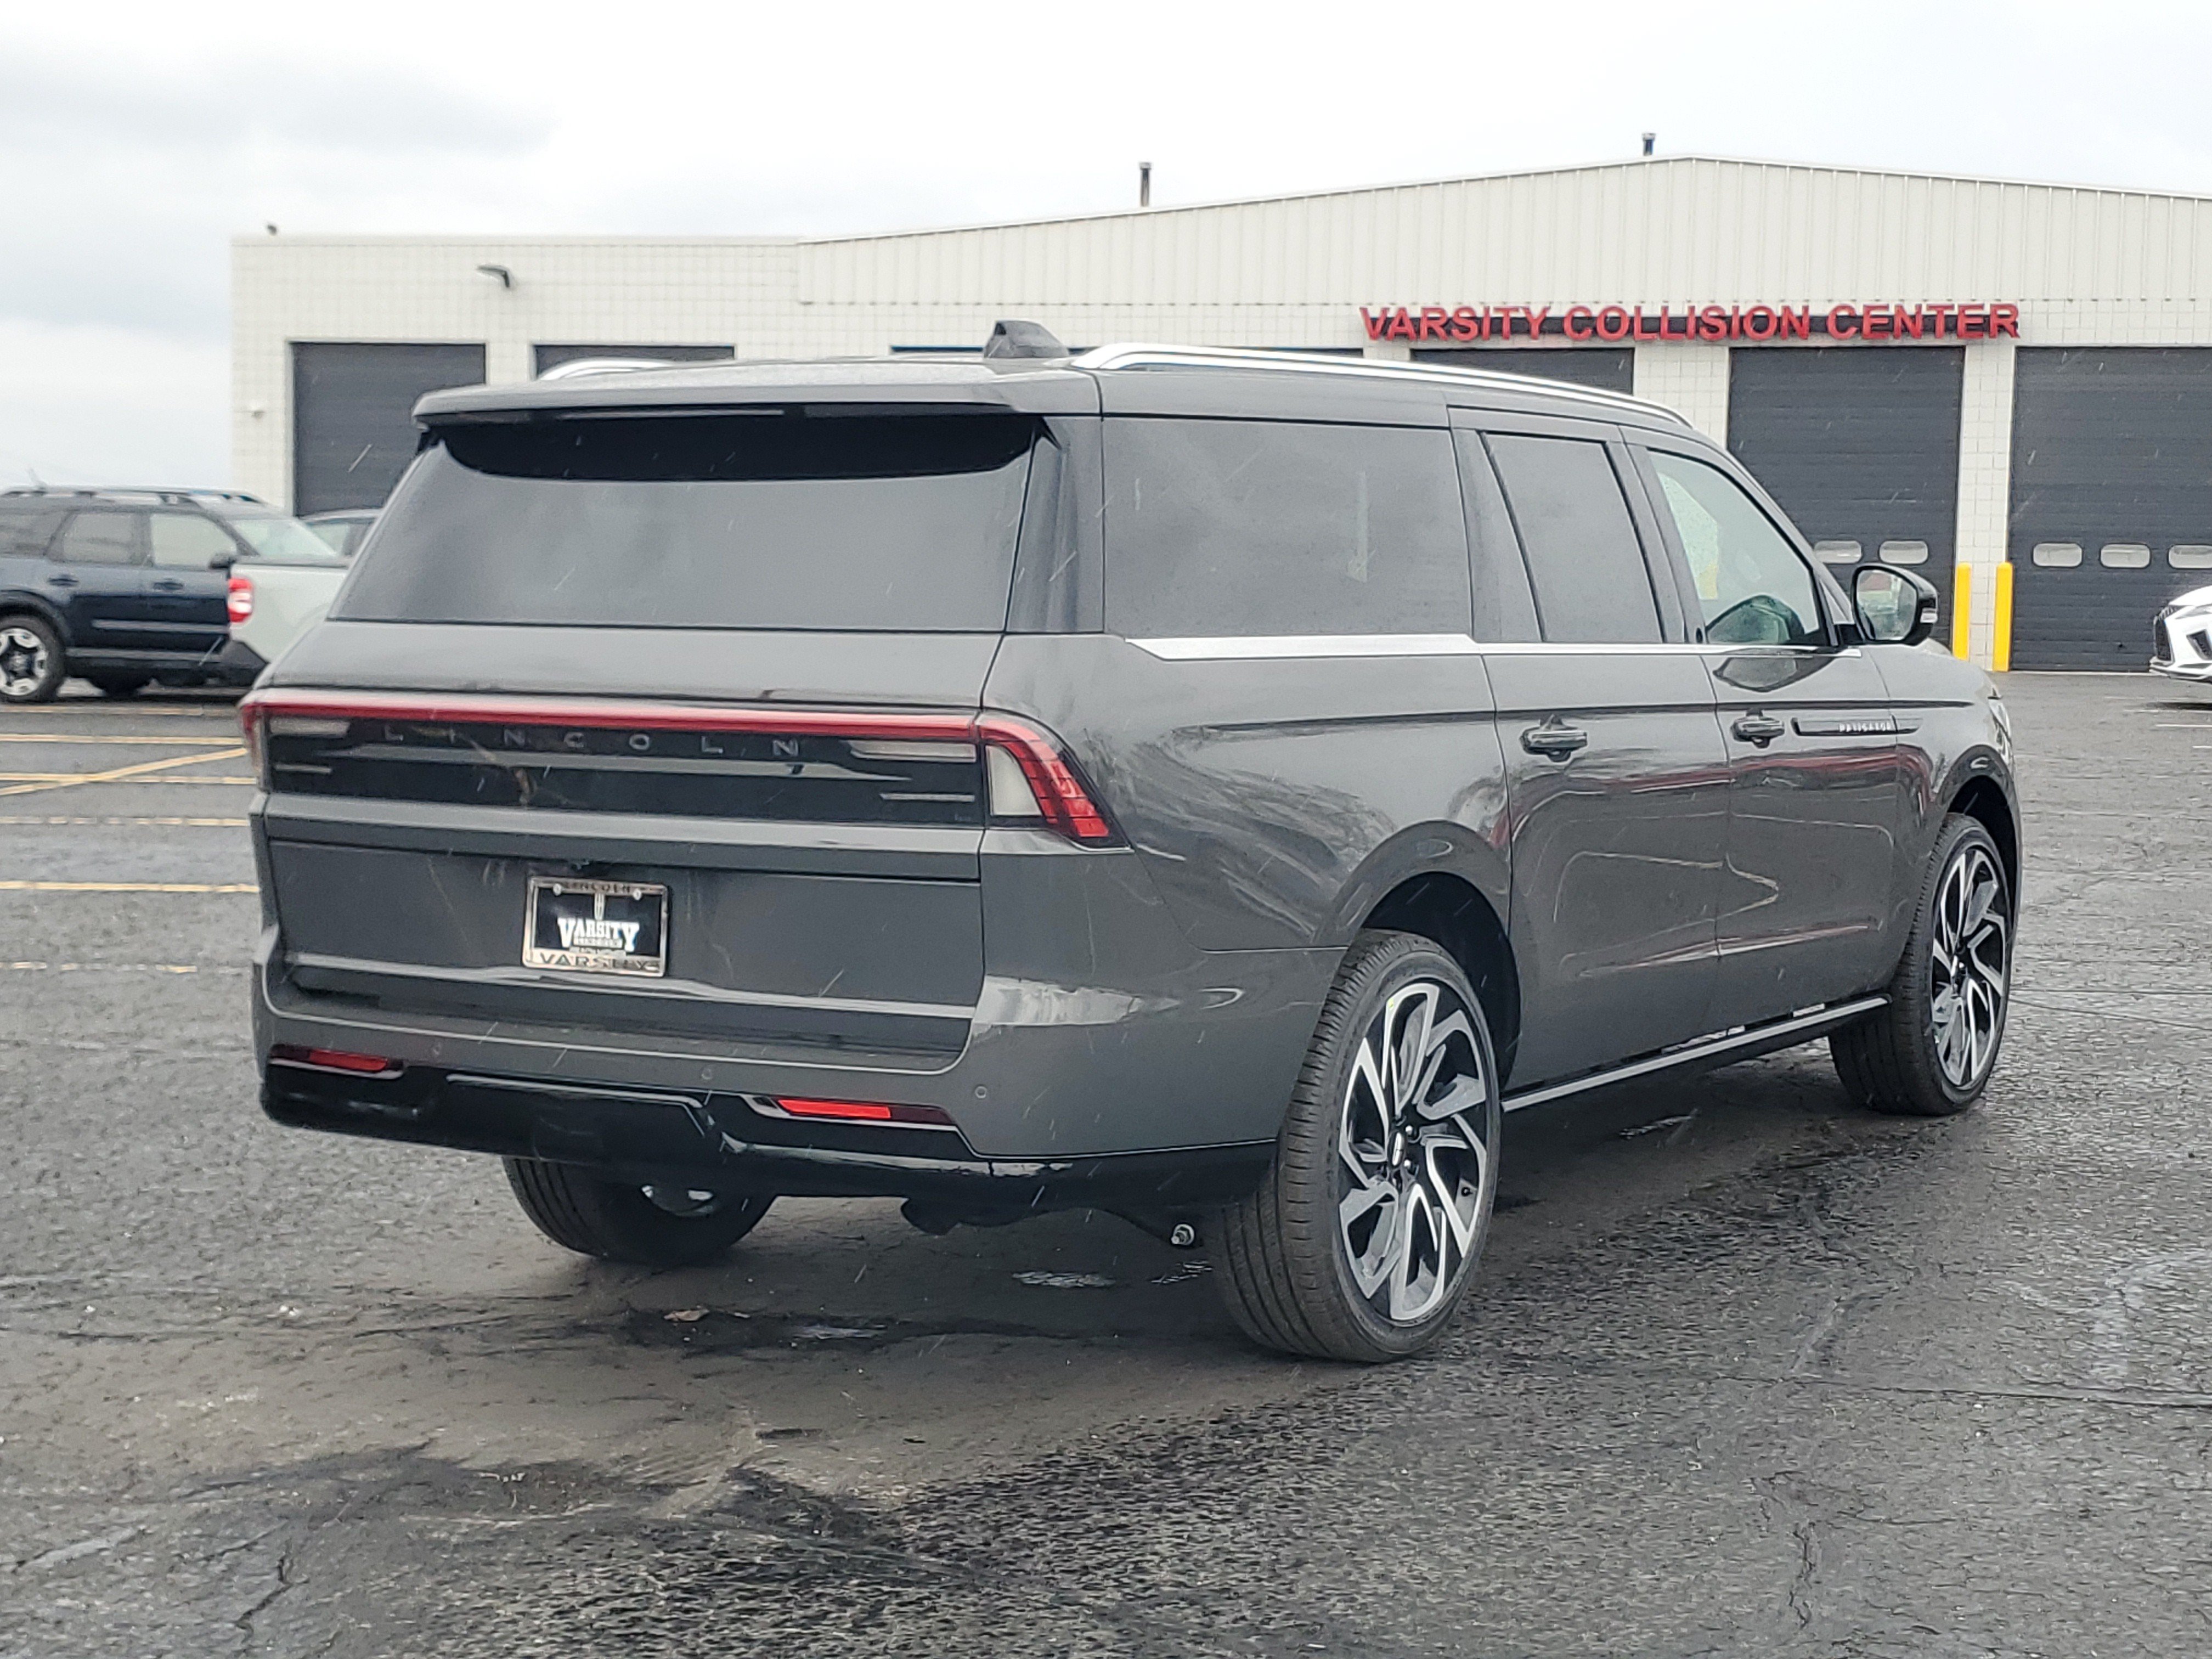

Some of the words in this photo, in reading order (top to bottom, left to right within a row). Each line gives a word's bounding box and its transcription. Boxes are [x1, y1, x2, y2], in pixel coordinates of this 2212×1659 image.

[1360, 304, 1551, 341] VARSITY
[1563, 304, 1809, 341] COLLISION
[1827, 303, 2021, 340] CENTER
[384, 724, 799, 756] LINCOLN
[557, 917, 640, 952] VARSITY
